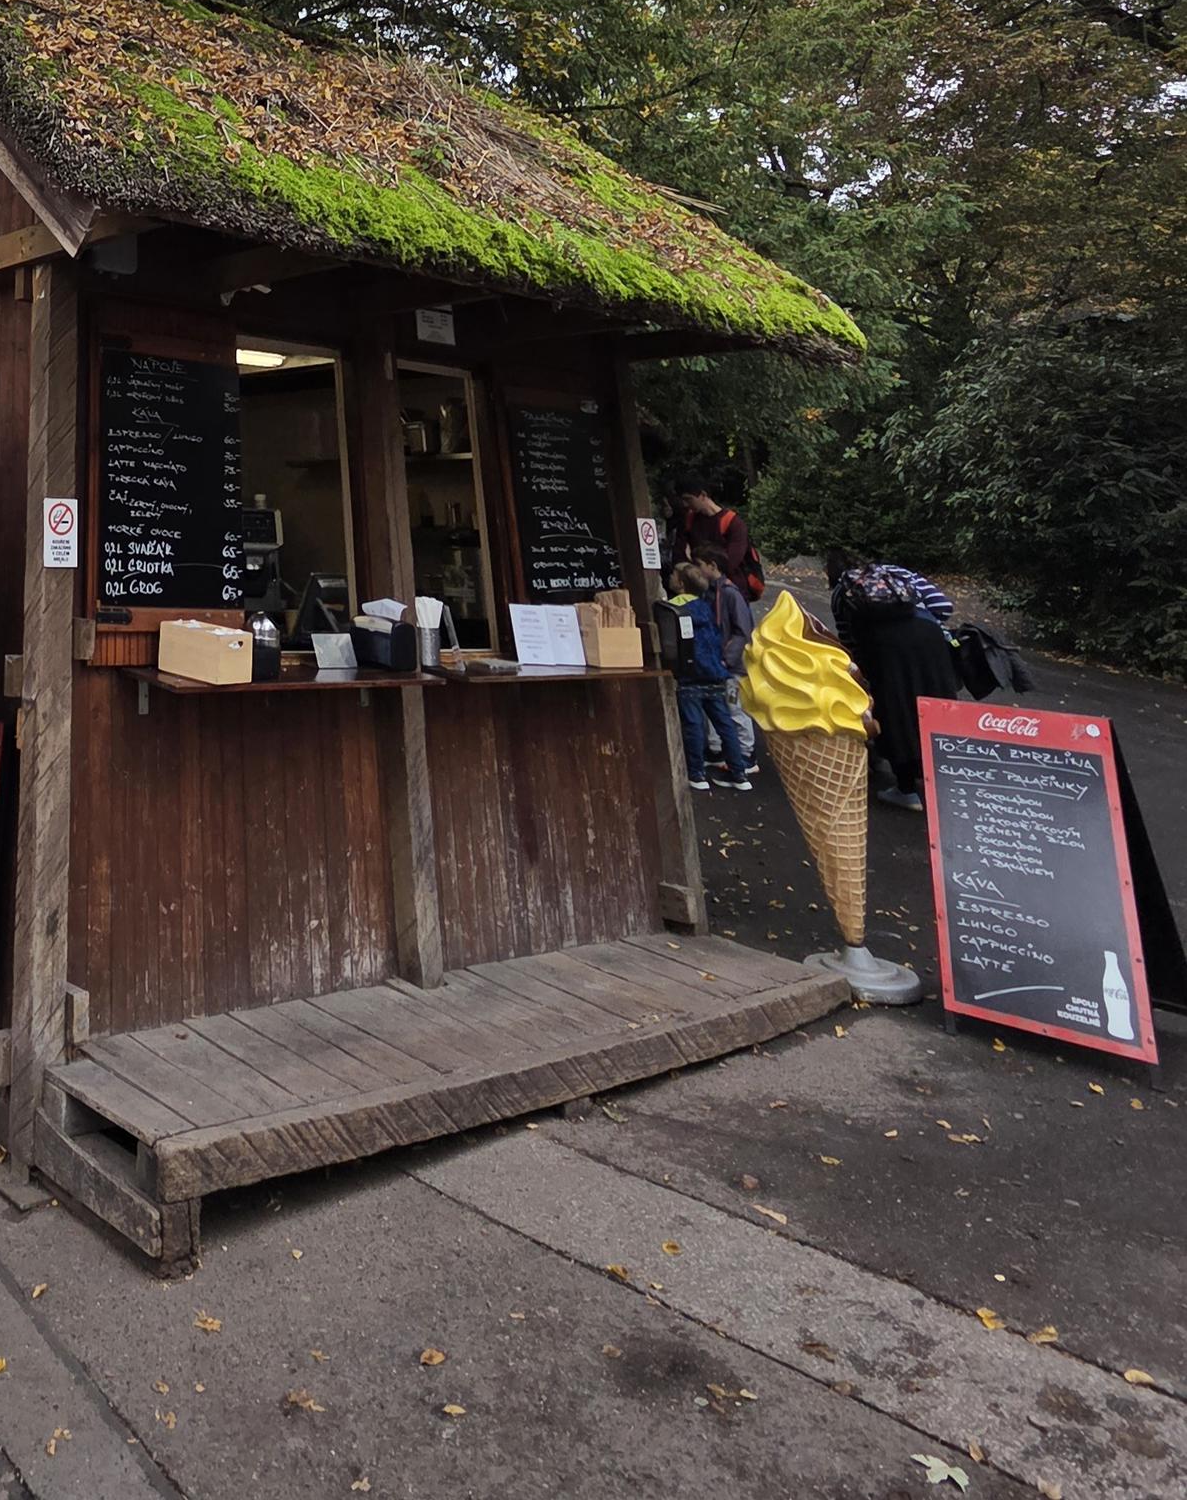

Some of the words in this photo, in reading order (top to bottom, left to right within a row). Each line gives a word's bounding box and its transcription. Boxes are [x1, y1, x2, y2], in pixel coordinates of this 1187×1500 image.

[108, 459, 135, 469] LATTE
[150, 528, 182, 539] OVOCE
[104, 541, 123, 557] 0,2L
[105, 558, 125, 576] 0,2L
[128, 558, 174, 576] GRIOTKA
[105, 580, 127, 597] 0,2L
[130, 579, 163, 594] GROG
[978, 712, 1041, 737] Coca-Cola
[935, 737, 1002, 762] TOČENÁ
[938, 764, 998, 782] SLADKÉ
[1002, 769, 1088, 800] PALAČINKY
[975, 788, 1042, 807] ČOKOLÁDOU
[974, 800, 1054, 821] MARMELÁDOU
[975, 833, 1042, 853] ČOKOLÁDOU
[978, 845, 1043, 865] ČOKOLÁDOU
[952, 870, 1005, 899] KÁVA
[956, 900, 1050, 928] ESPRESSO
[957, 917, 1018, 938] LUNGO
[959, 935, 1055, 965] CAPPUCCINO
